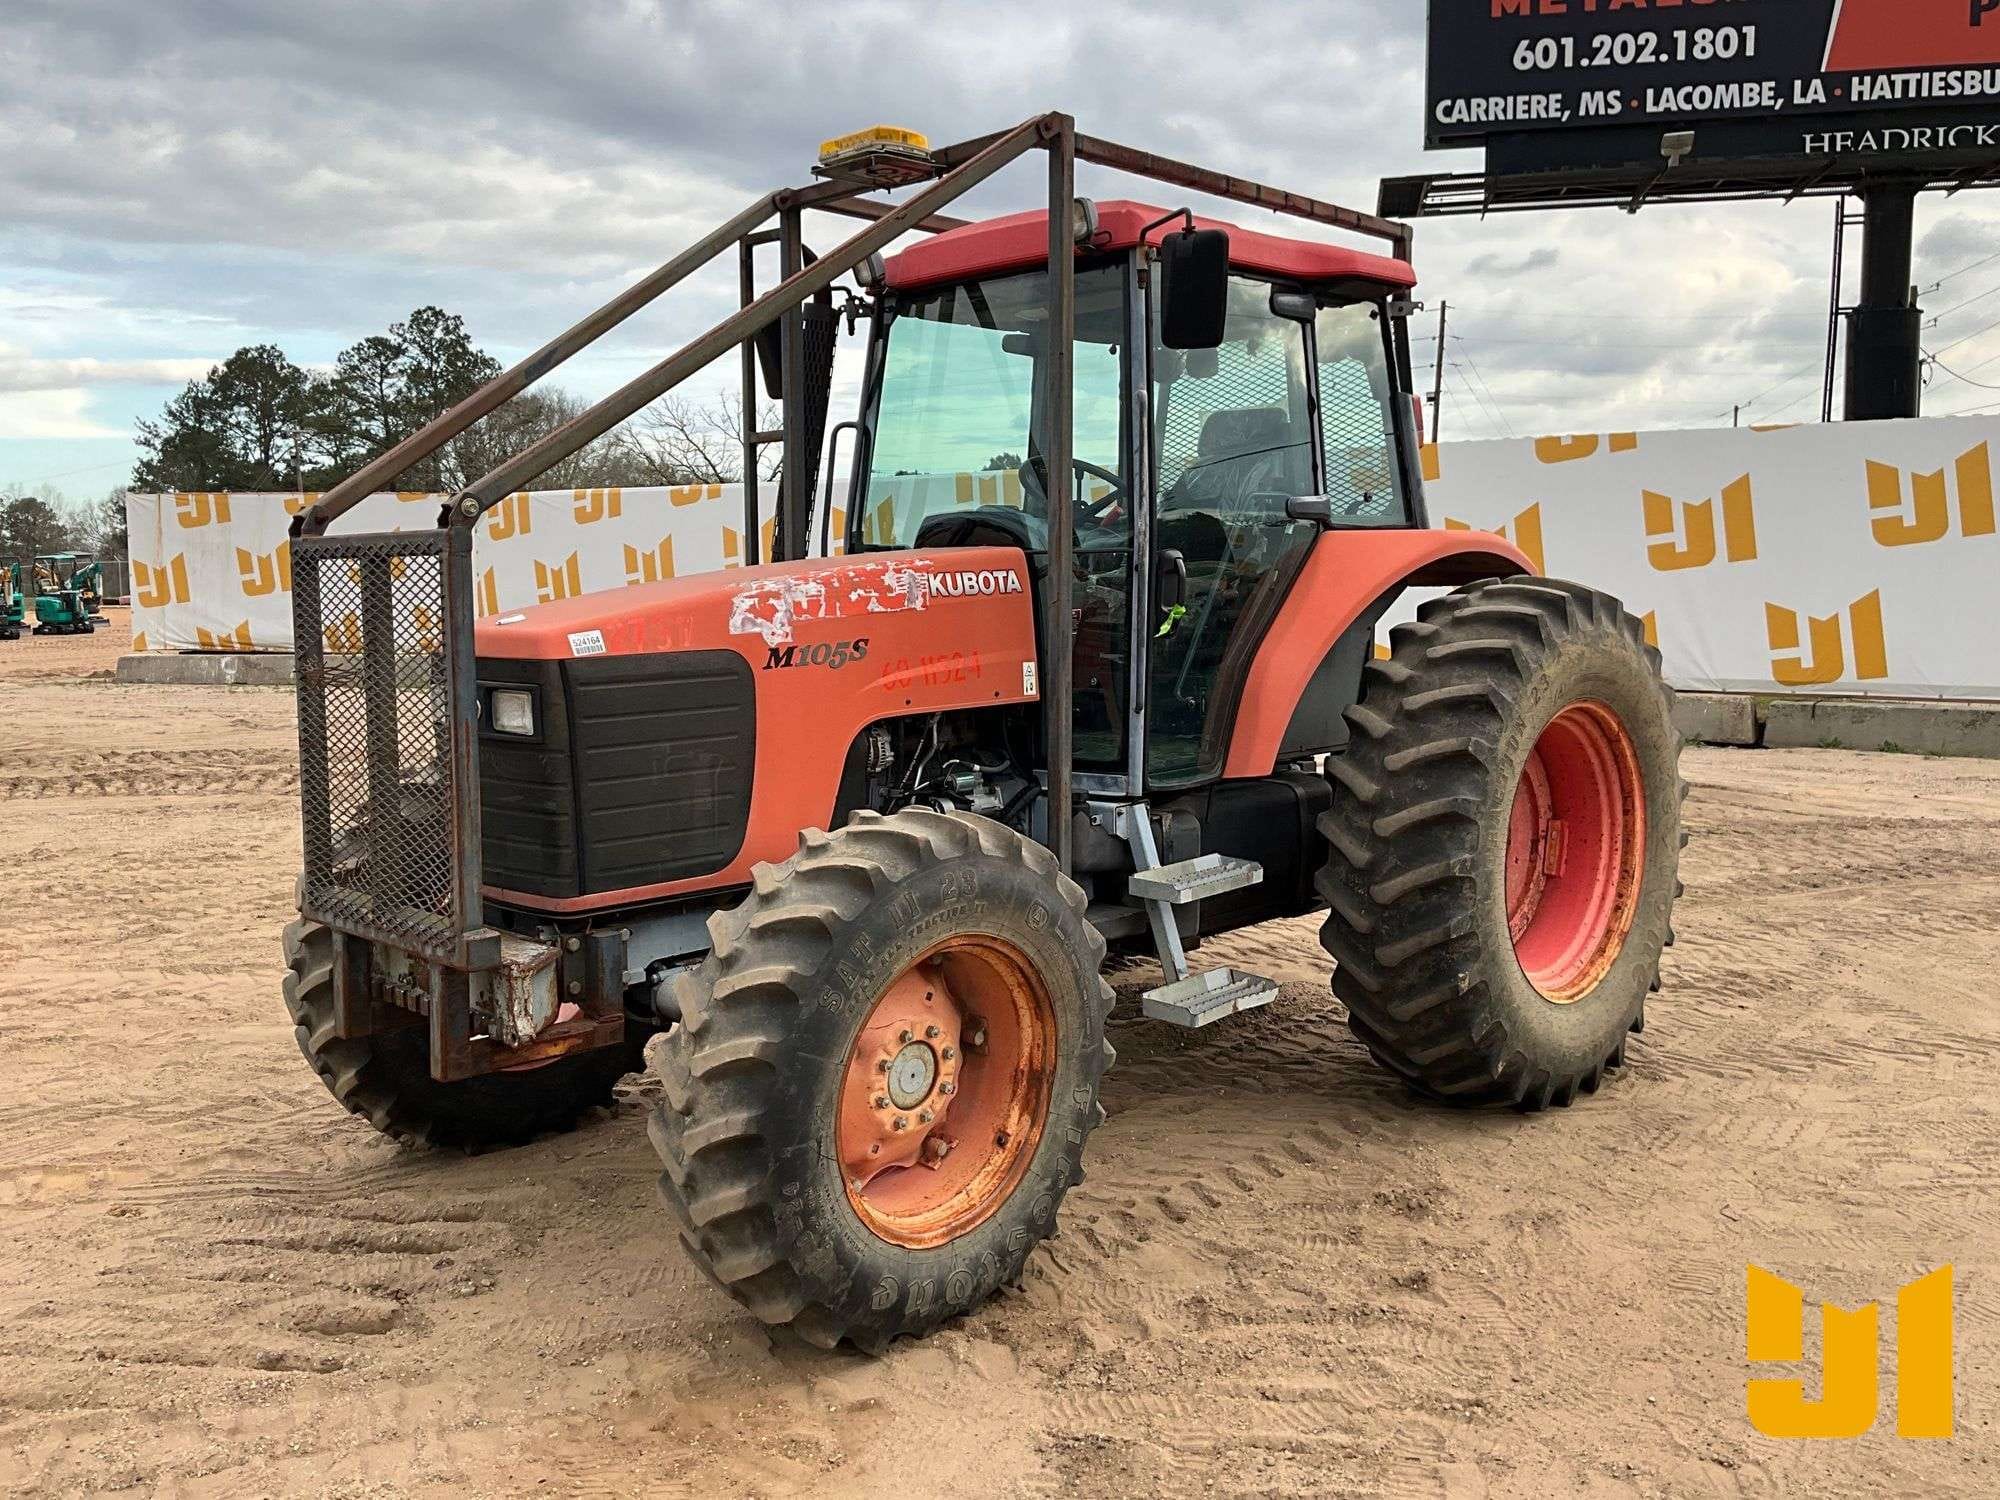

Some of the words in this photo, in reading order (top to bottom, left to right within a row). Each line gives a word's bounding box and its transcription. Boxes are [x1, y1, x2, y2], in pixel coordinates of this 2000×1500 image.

[1512, 25, 1756, 72] 601.202.1801
[1435, 92, 1571, 124] CARRIERE,
[1578, 89, 1623, 117] MS
[1645, 80, 1784, 114] LACOMBE,
[1793, 78, 1827, 105] LA
[927, 567, 1024, 599] KUBOTA
[572, 635, 601, 648] 524164
[762, 638, 870, 671] M105S
